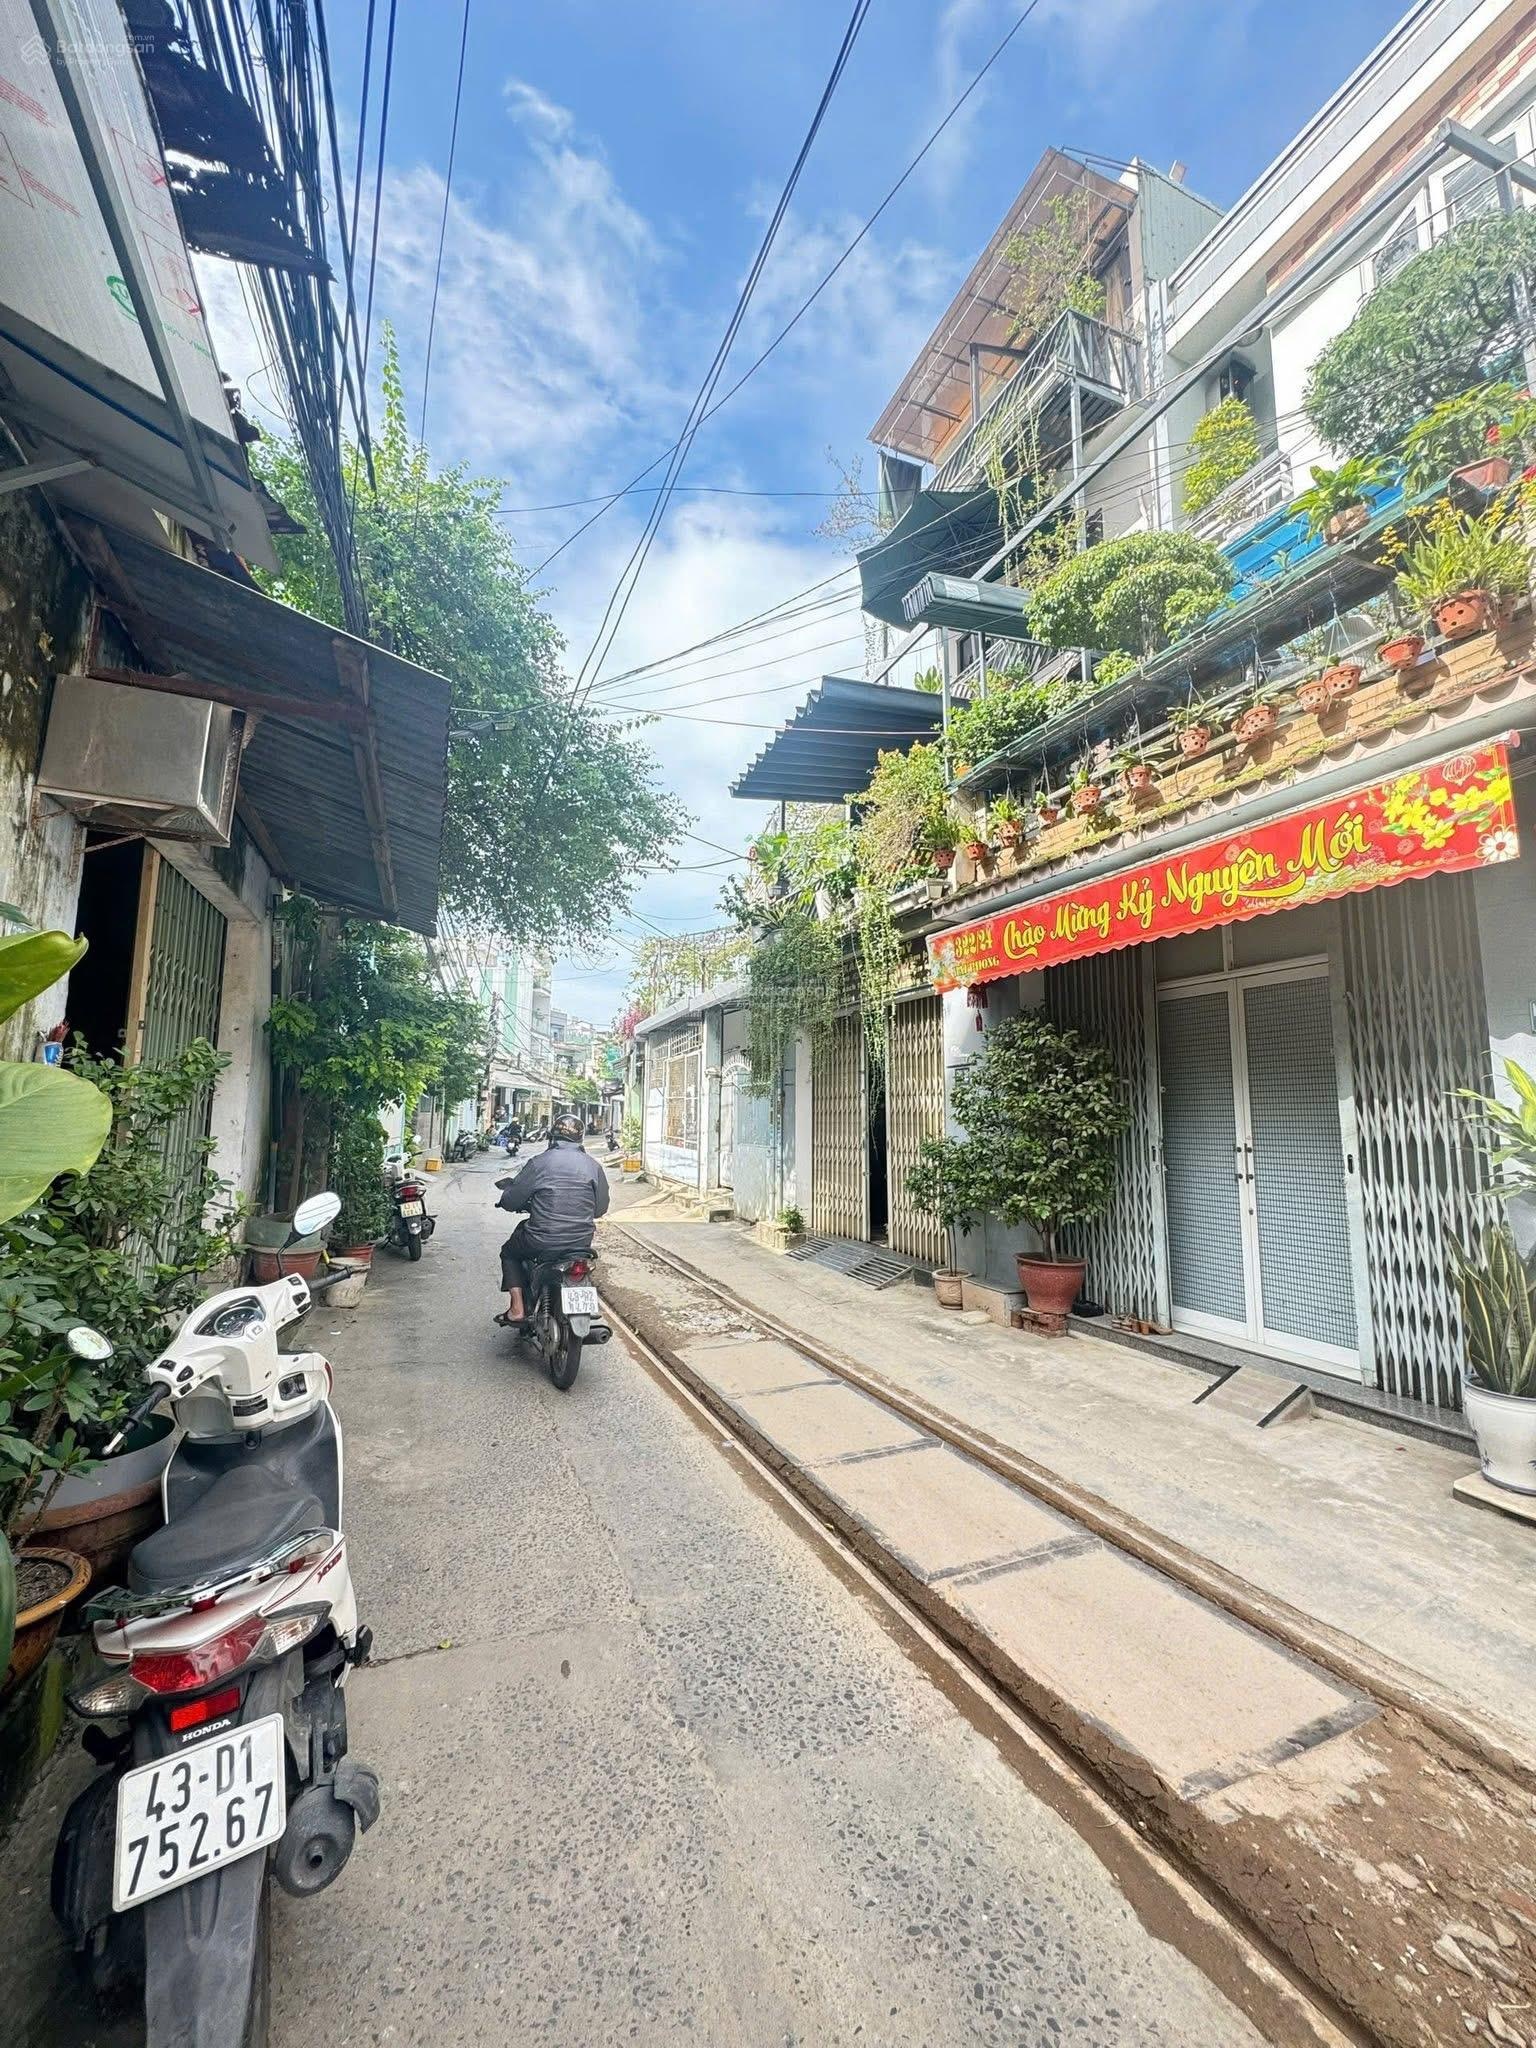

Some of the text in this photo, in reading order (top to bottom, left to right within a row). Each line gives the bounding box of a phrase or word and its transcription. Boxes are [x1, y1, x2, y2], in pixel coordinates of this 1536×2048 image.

[1003, 811, 1372, 960] Chào Mừng Kỷ Nguyên Mới
[955, 927, 993, 957] 322/24
[182, 1718, 231, 1742] HONDA
[146, 1734, 253, 1823] 43-D1
[128, 1781, 273, 1897] 752.67
